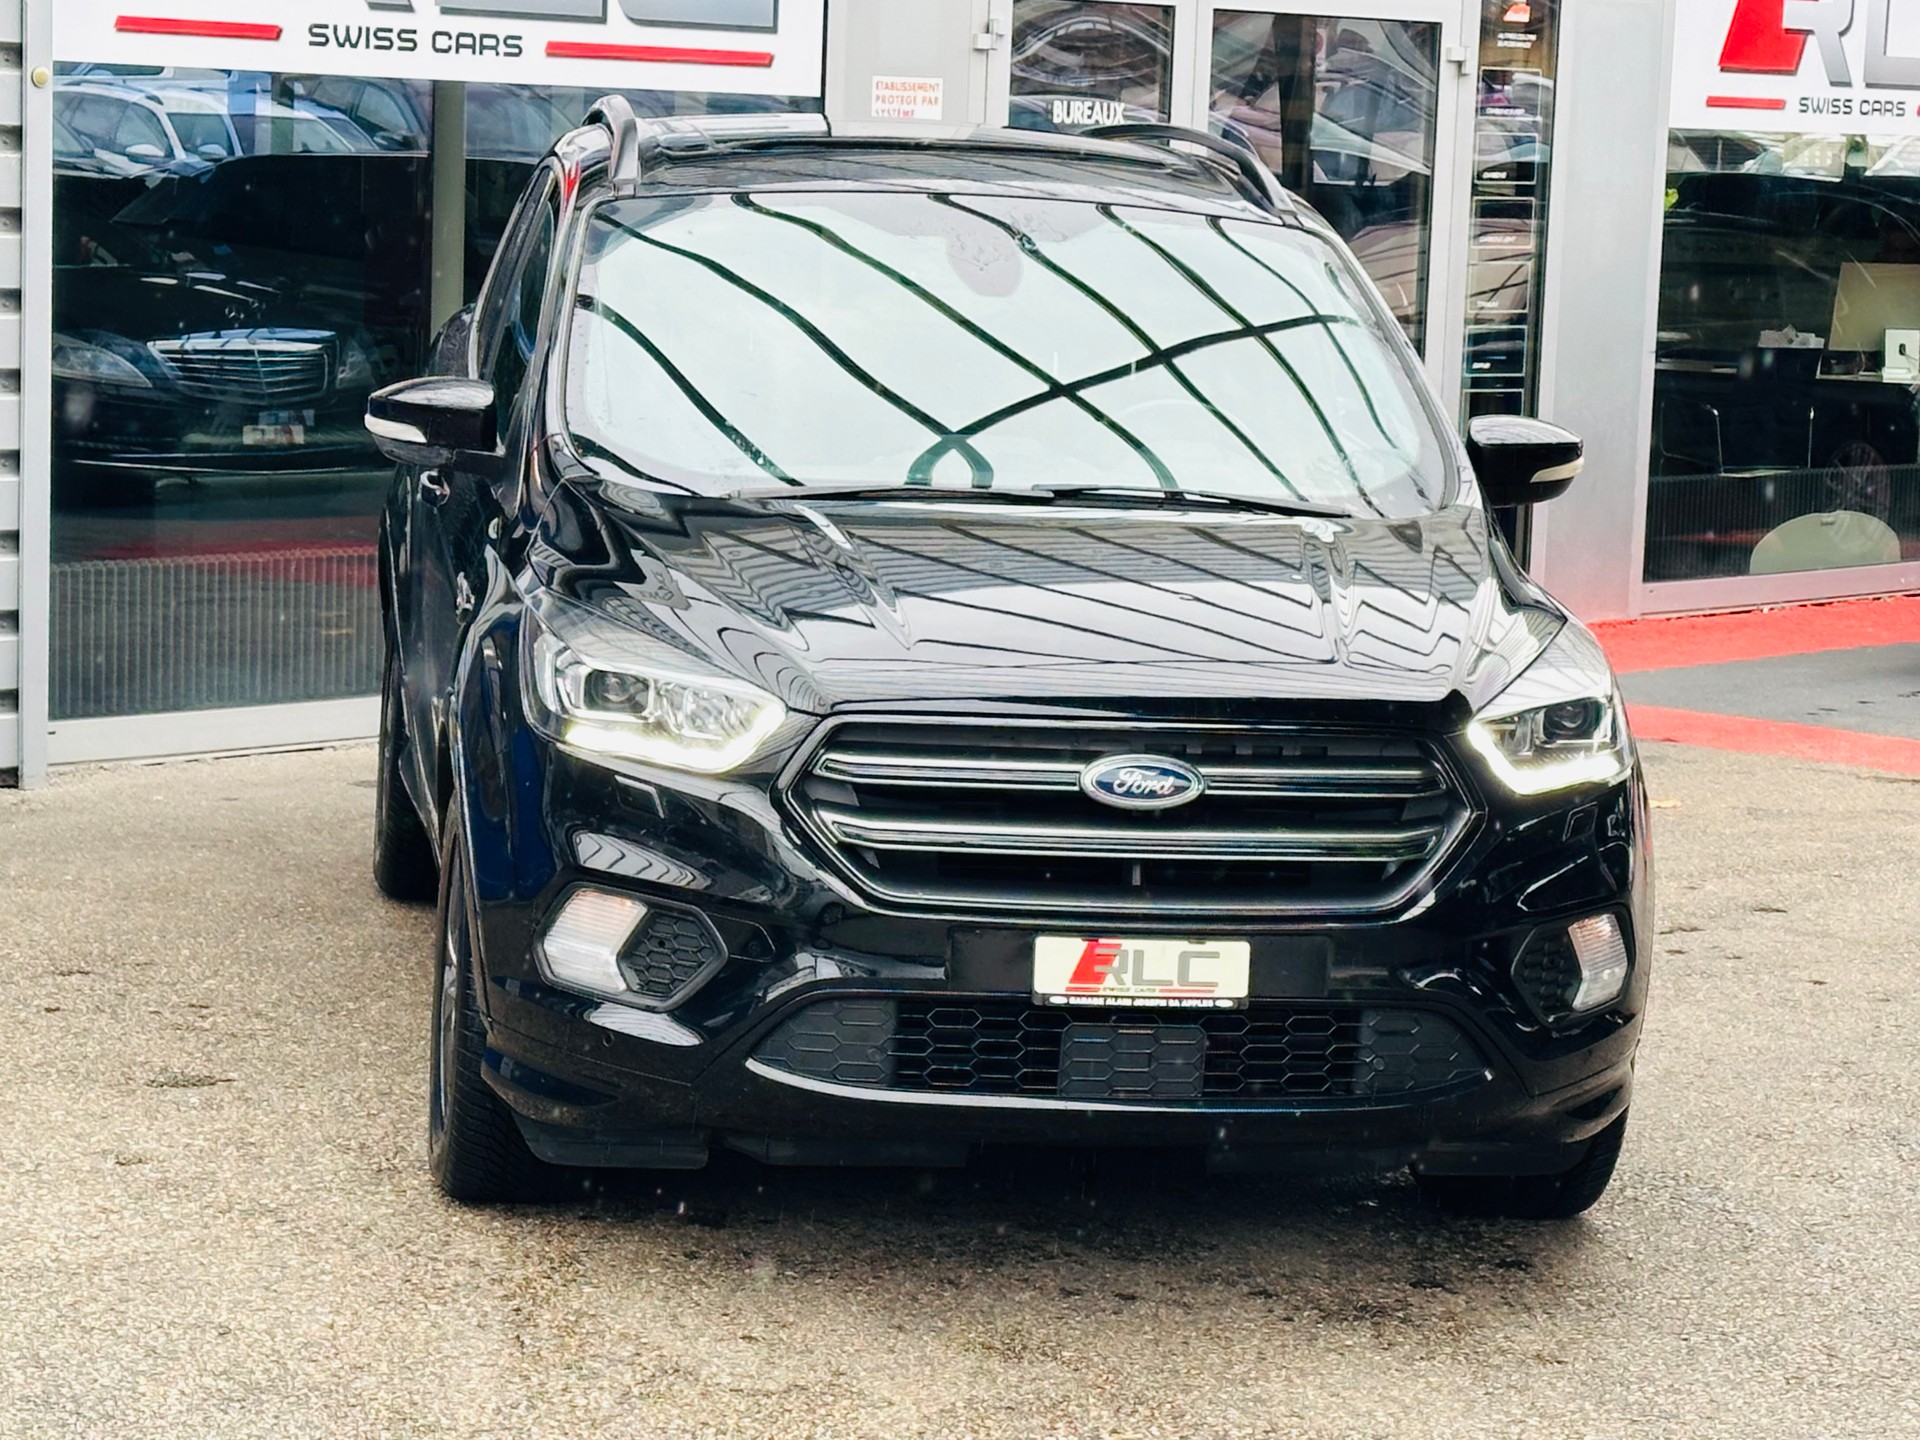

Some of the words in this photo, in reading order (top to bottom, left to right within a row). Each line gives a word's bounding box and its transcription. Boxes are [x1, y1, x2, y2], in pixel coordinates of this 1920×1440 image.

[308, 23, 418, 52] SWISS
[431, 30, 524, 58] CARS
[1053, 100, 1125, 125] BUREAUX
[1798, 97, 1853, 115] SWISS
[1859, 100, 1906, 117] CARS
[1113, 767, 1175, 795] Ford
